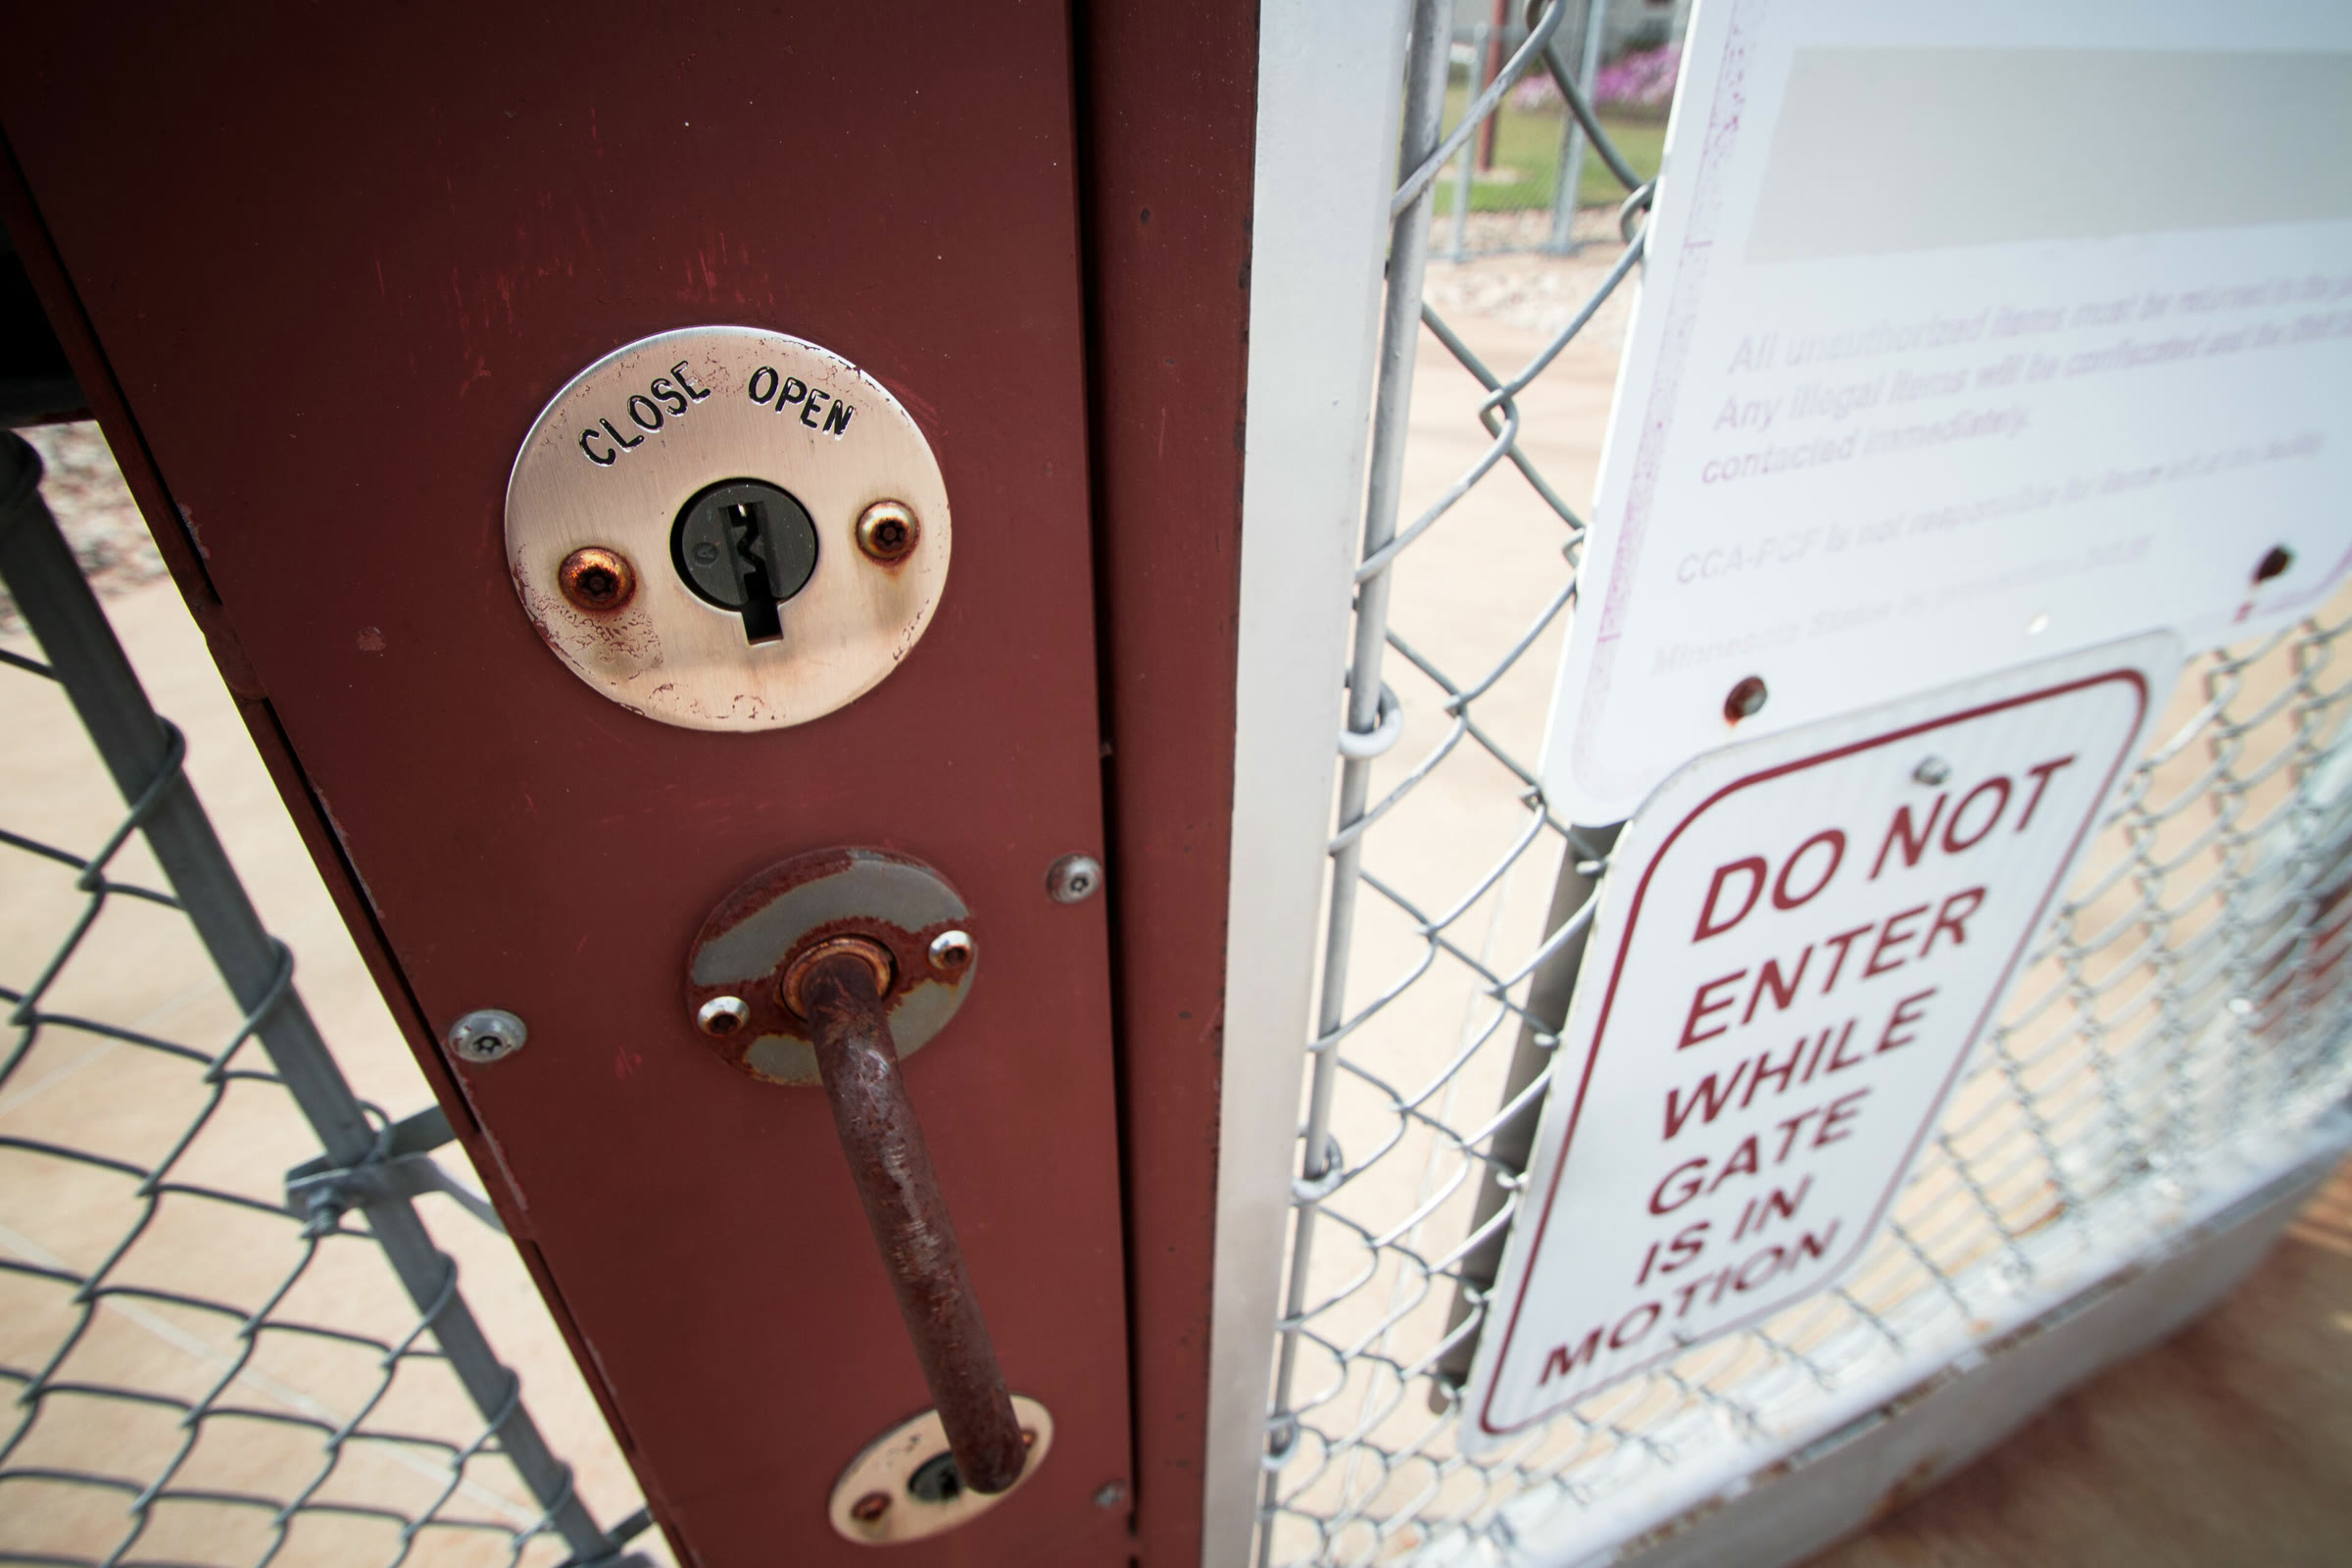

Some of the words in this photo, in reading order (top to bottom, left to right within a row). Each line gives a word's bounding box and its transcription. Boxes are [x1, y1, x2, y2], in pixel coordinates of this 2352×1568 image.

[1727, 331, 1779, 375] All
[1785, 306, 1991, 368] unauthorized
[579, 360, 712, 466] CLOSE
[748, 366, 855, 440] OPEN
[1701, 428, 1860, 484] contacted
[1713, 394, 1781, 433] Any
[1789, 373, 1886, 421] illegal
[1690, 827, 1849, 944] DO
[1866, 754, 2077, 881] NOT
[1675, 885, 1988, 1052] ENTER
[1661, 988, 1939, 1142] WHILE
[1647, 1086, 1874, 1216] GATE
[1635, 1219, 1707, 1287] IS
[1731, 1172, 1815, 1244] IN
[1538, 1219, 1843, 1388] MOTION
